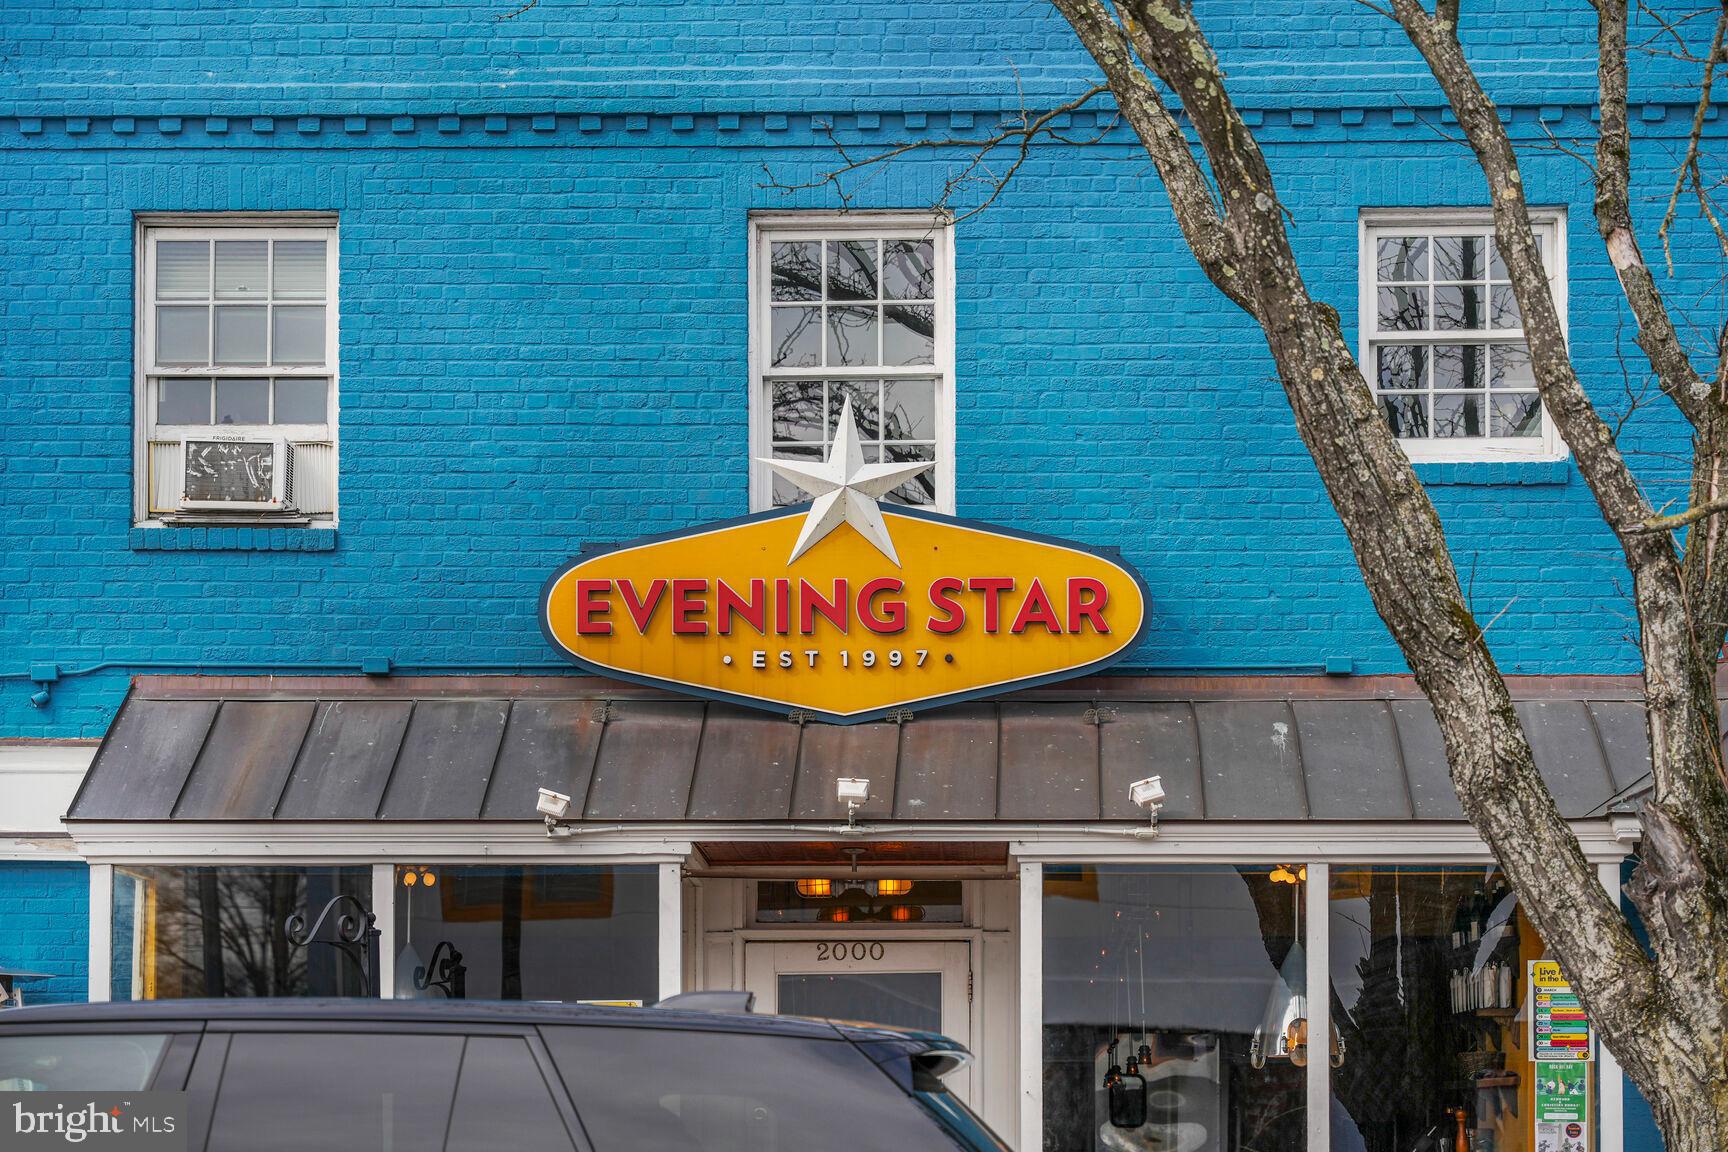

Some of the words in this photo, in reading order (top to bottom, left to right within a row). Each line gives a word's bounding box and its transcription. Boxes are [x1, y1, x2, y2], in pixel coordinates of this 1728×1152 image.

[576, 577, 907, 636] EVENING
[926, 576, 1111, 635] STAR
[752, 650, 819, 668] EST
[840, 649, 928, 668] 1997
[817, 942, 885, 961] 2000
[1540, 967, 1556, 975] Live
